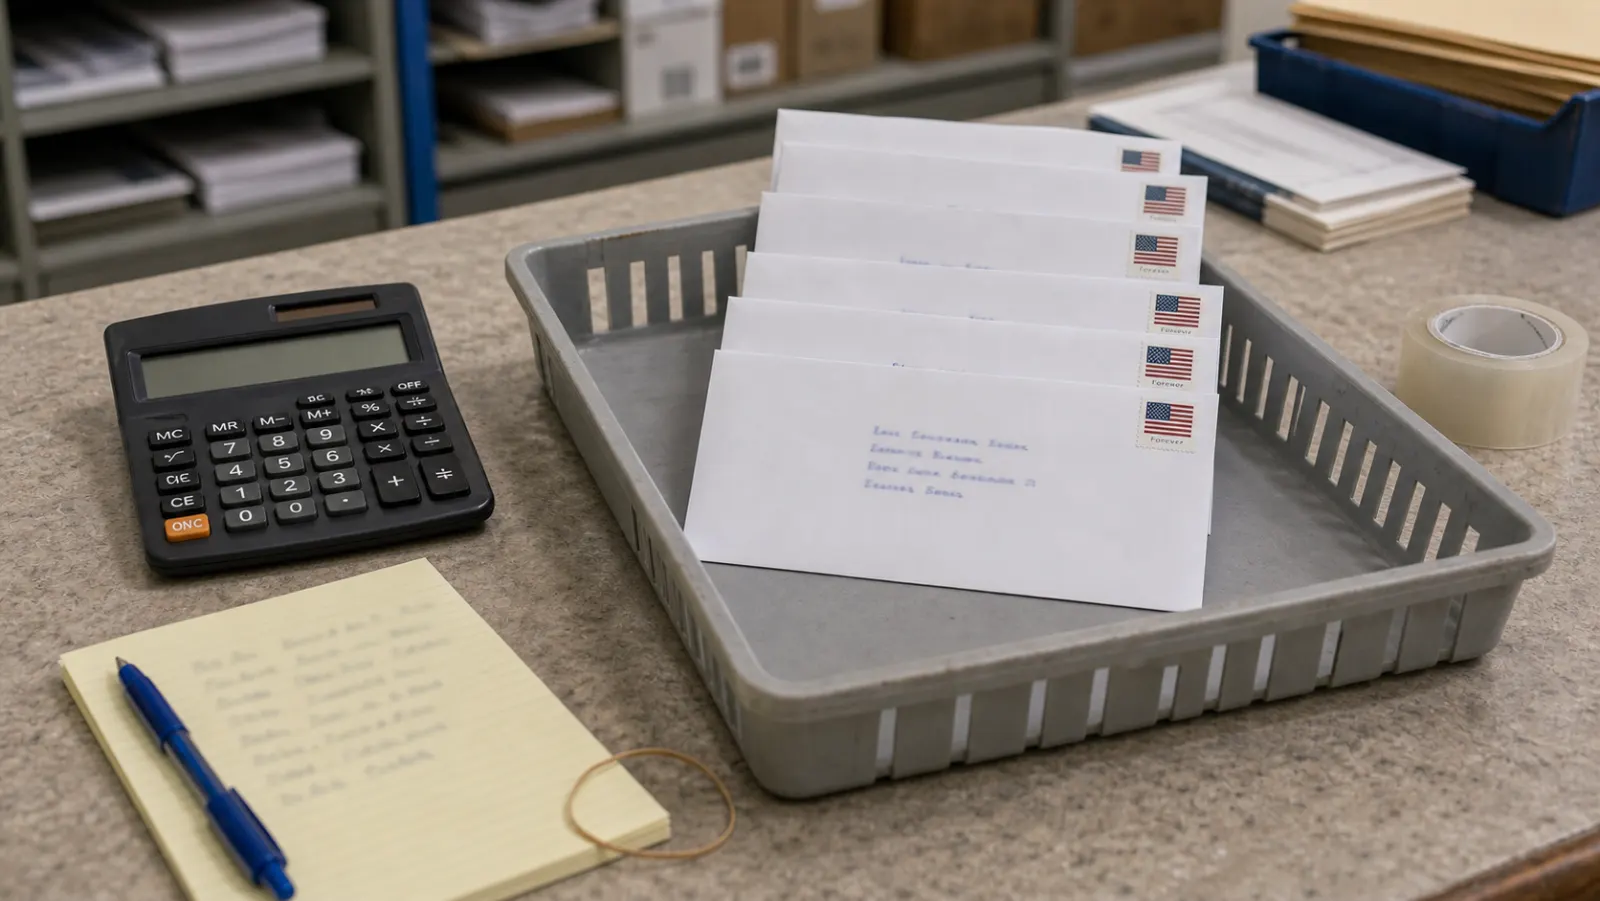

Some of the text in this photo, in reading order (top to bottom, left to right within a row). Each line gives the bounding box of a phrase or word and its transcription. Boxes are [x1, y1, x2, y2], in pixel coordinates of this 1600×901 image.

[397, 381, 421, 390] OFF
[212, 421, 238, 432] MR
[156, 429, 183, 440] MC
[320, 429, 332, 440] 9
[272, 435, 285, 447] 8
[223, 442, 236, 454] 7
[326, 450, 339, 461] 6
[278, 457, 291, 469] 5
[229, 464, 243, 476] 4
[332, 472, 346, 484] 3
[283, 479, 298, 492] 2
[235, 487, 246, 499] 1
[170, 495, 195, 508] CE
[289, 502, 302, 513] 0
[239, 510, 253, 522] 0
[172, 518, 203, 531] ONC
